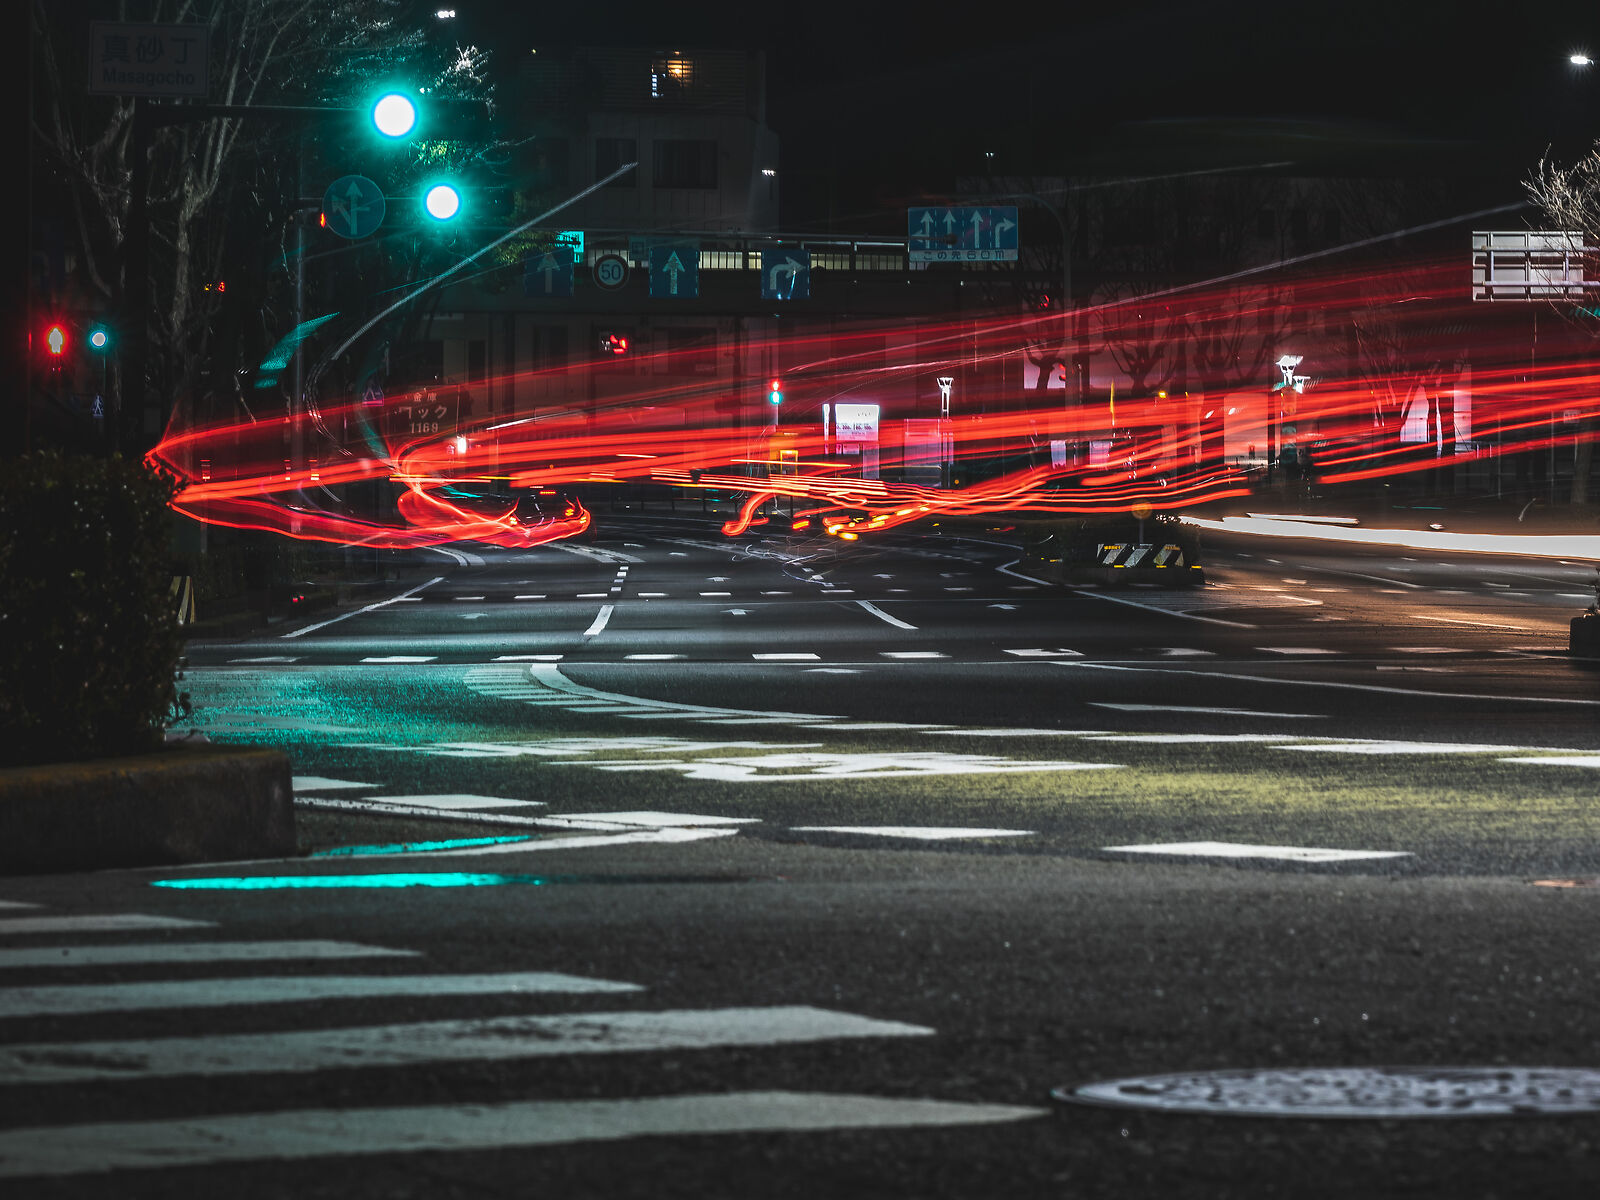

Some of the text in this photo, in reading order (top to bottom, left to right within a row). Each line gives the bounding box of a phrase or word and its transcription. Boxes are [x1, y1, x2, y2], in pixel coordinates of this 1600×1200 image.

[102, 34, 198, 65] 真砂丁
[103, 67, 195, 87] Masagocho
[601, 264, 621, 280] 50
[410, 422, 439, 434] 1169
